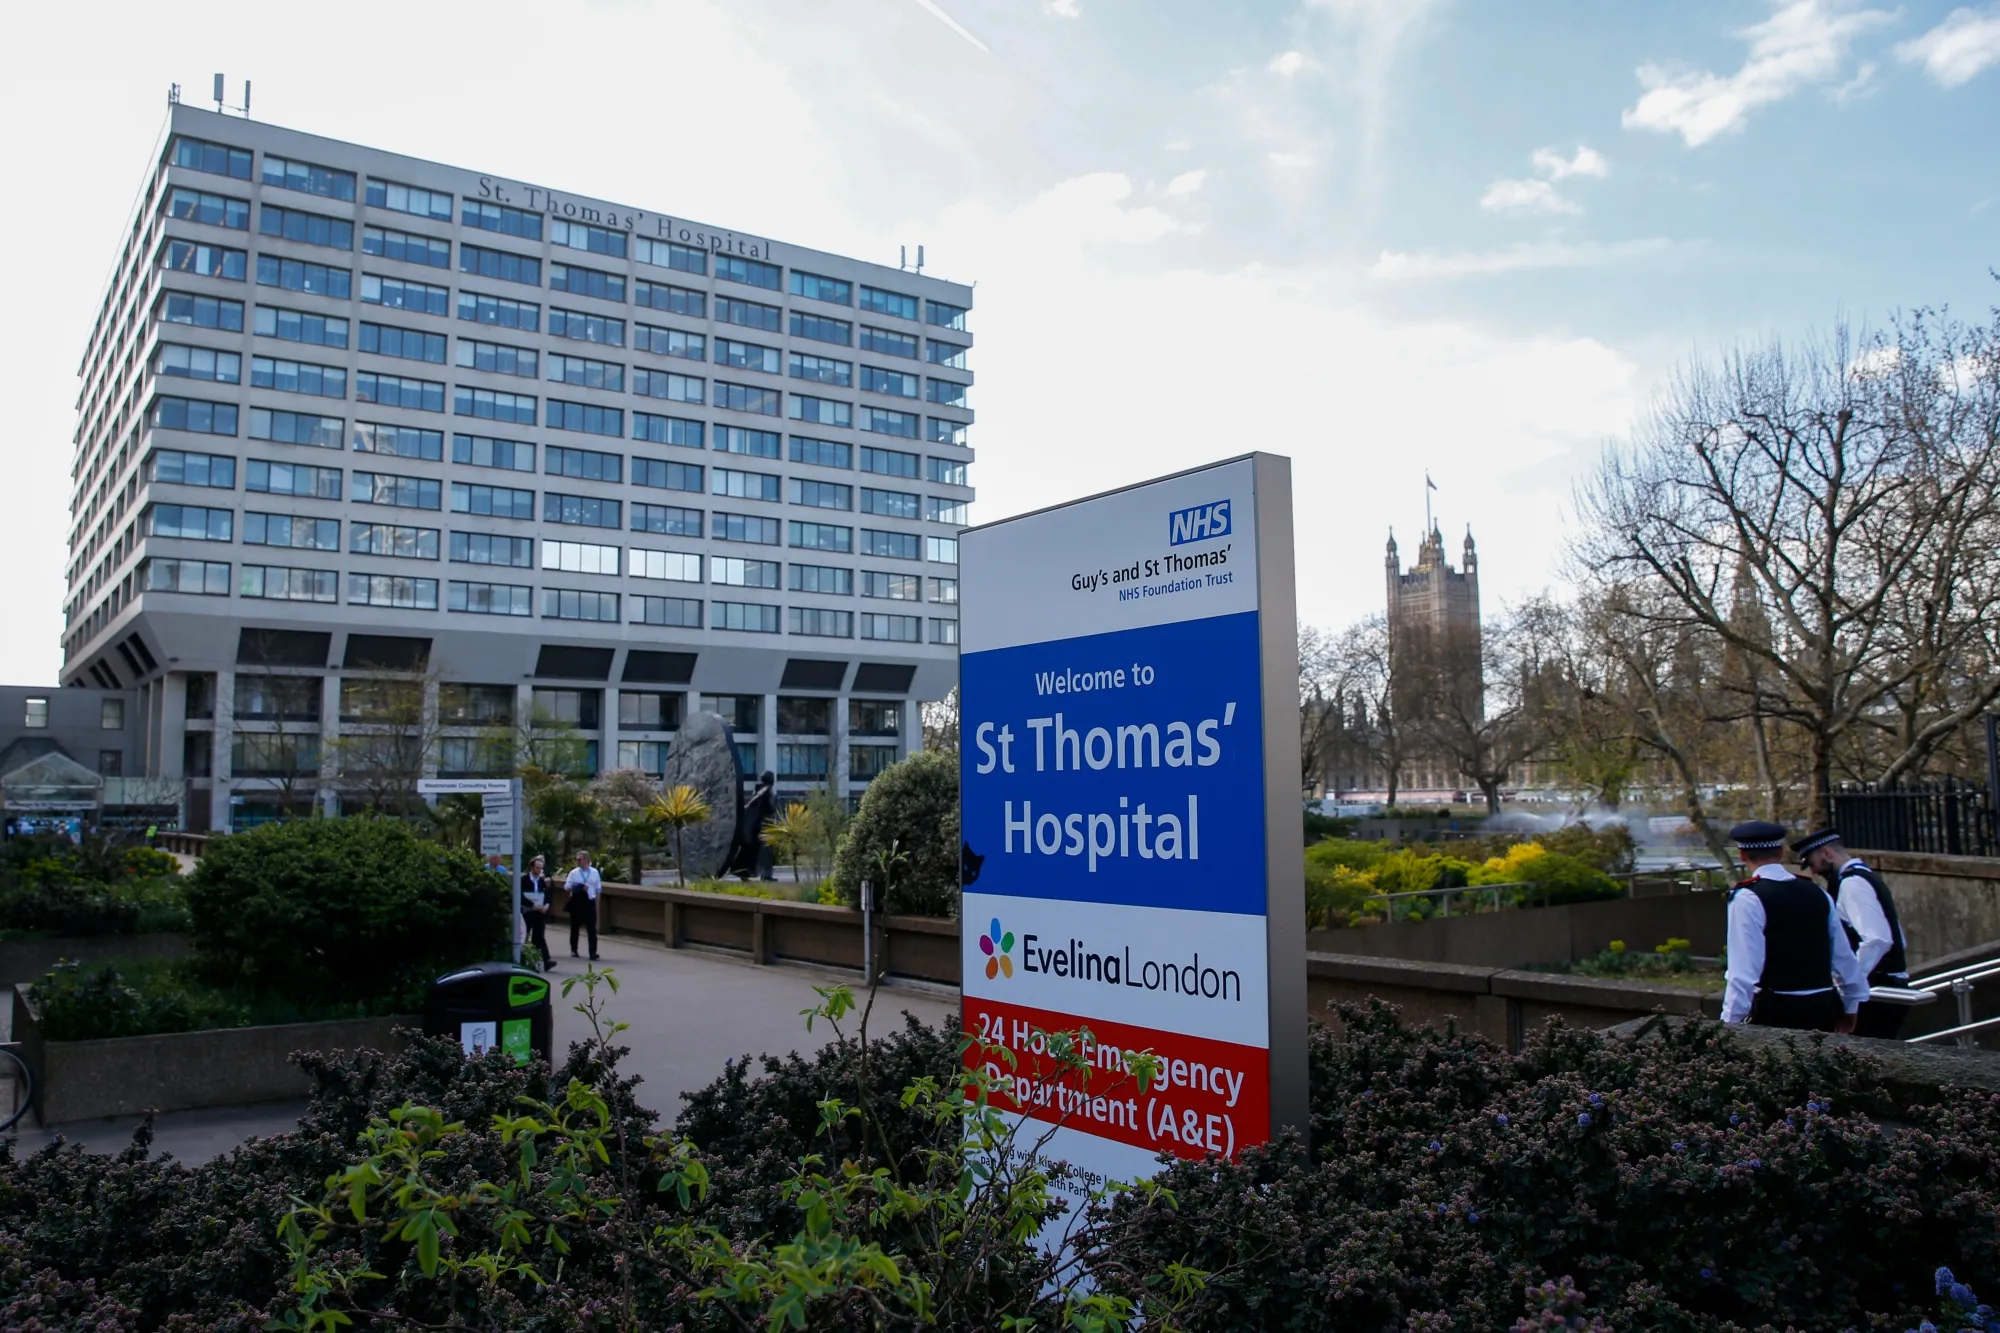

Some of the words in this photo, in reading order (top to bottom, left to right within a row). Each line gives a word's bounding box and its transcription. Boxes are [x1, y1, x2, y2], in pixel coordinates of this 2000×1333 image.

[478, 176, 511, 203] St.
[524, 186, 645, 231] Thomas'
[657, 218, 771, 261] Hospital
[1171, 501, 1230, 544] NHS
[1071, 569, 1109, 592] Guy's
[1112, 561, 1140, 583] and
[1144, 559, 1160, 577] St
[1164, 544, 1232, 574] Thomas'
[1119, 587, 1140, 602] NHS
[1142, 577, 1202, 598] Foundation
[1205, 571, 1233, 586] Trust
[1035, 668, 1125, 696] Welcome
[1131, 662, 1155, 686] to
[975, 721, 1015, 774] St
[1026, 702, 1237, 772] Thomas'
[1004, 794, 1199, 873] Hospital
[978, 1012, 1005, 1047] 24
[1081, 1032, 1244, 1108] Emegency
[1146, 1097, 1235, 1161] (A&E)
[1068, 1181, 1107, 1205] Parts
